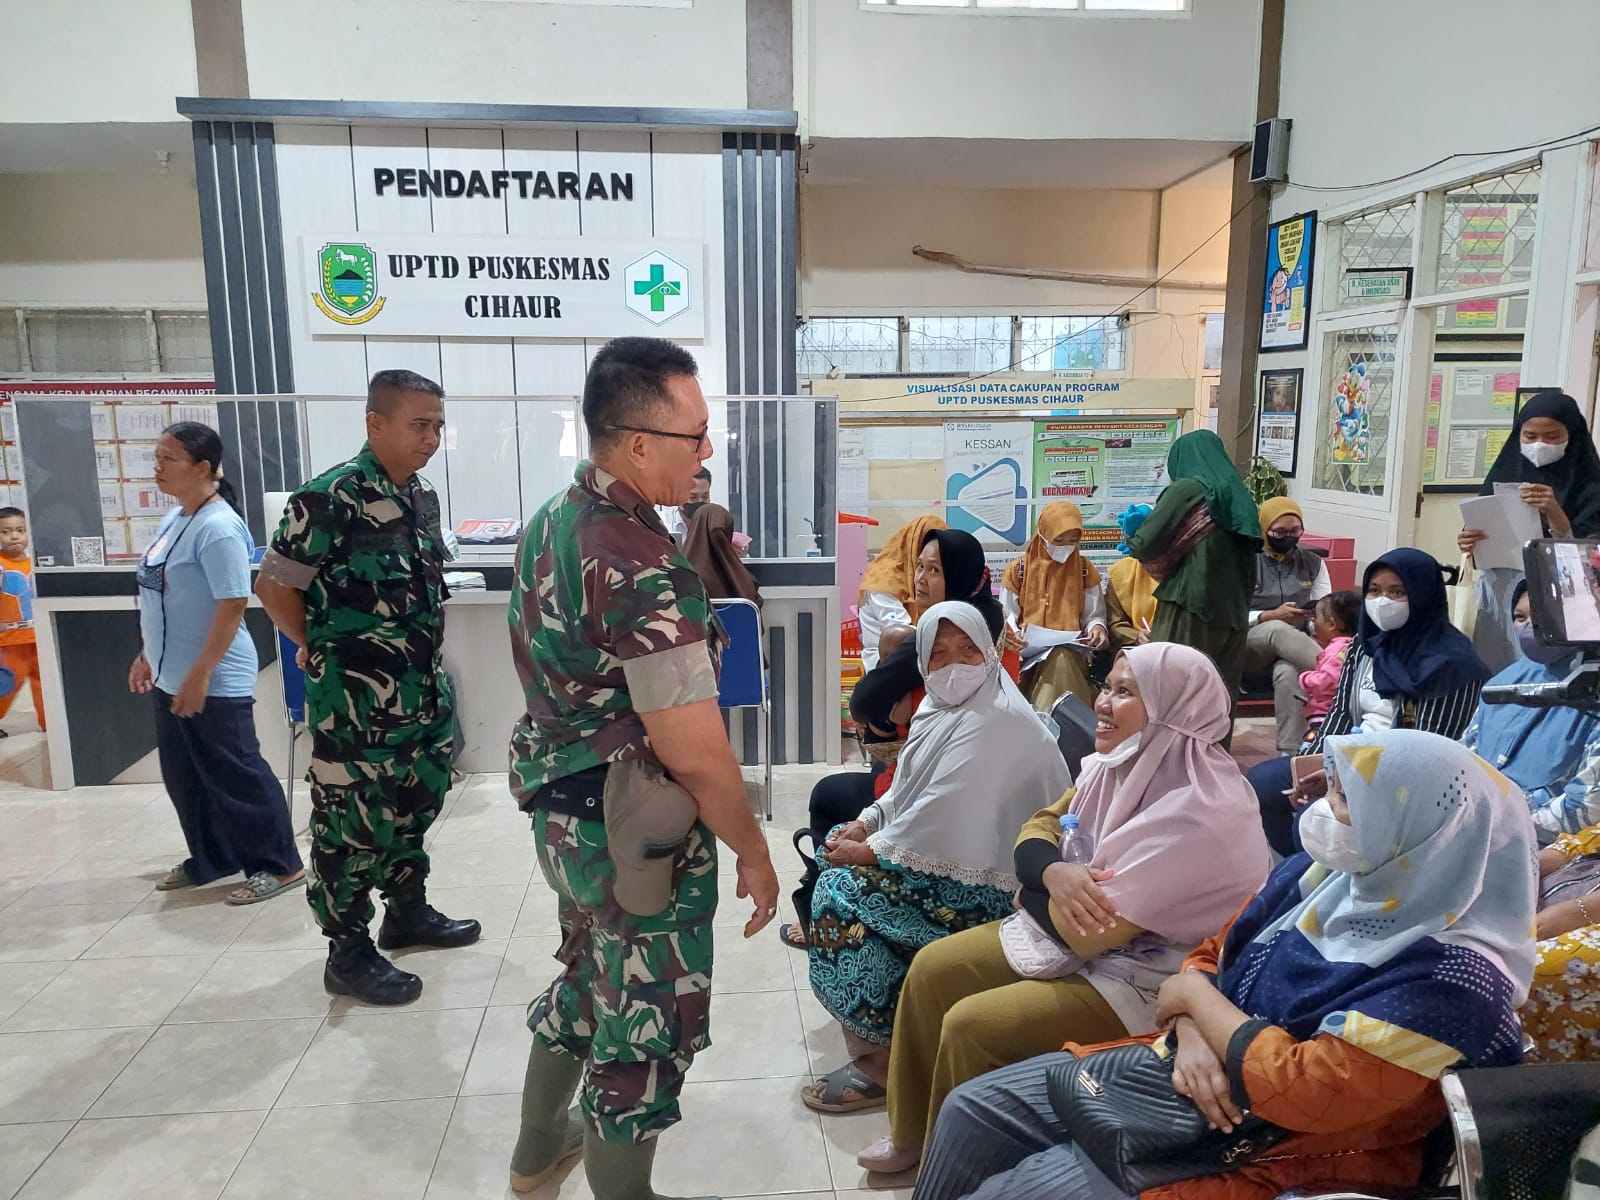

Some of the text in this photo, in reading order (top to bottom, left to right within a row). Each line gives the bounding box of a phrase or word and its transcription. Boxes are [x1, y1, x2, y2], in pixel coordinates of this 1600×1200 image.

[373, 167, 634, 201] PENDAFTARAN
[387, 254, 611, 281] UPTD PUSKESMAS
[464, 294, 562, 319] CIHAUR
[907, 383, 1120, 393] VISUALISASI DATA CAKUPAN PROGRAM
[937, 395, 1084, 405] UPTD PUSKESMAS CIHAUR
[965, 440, 1011, 449] KESSAN
